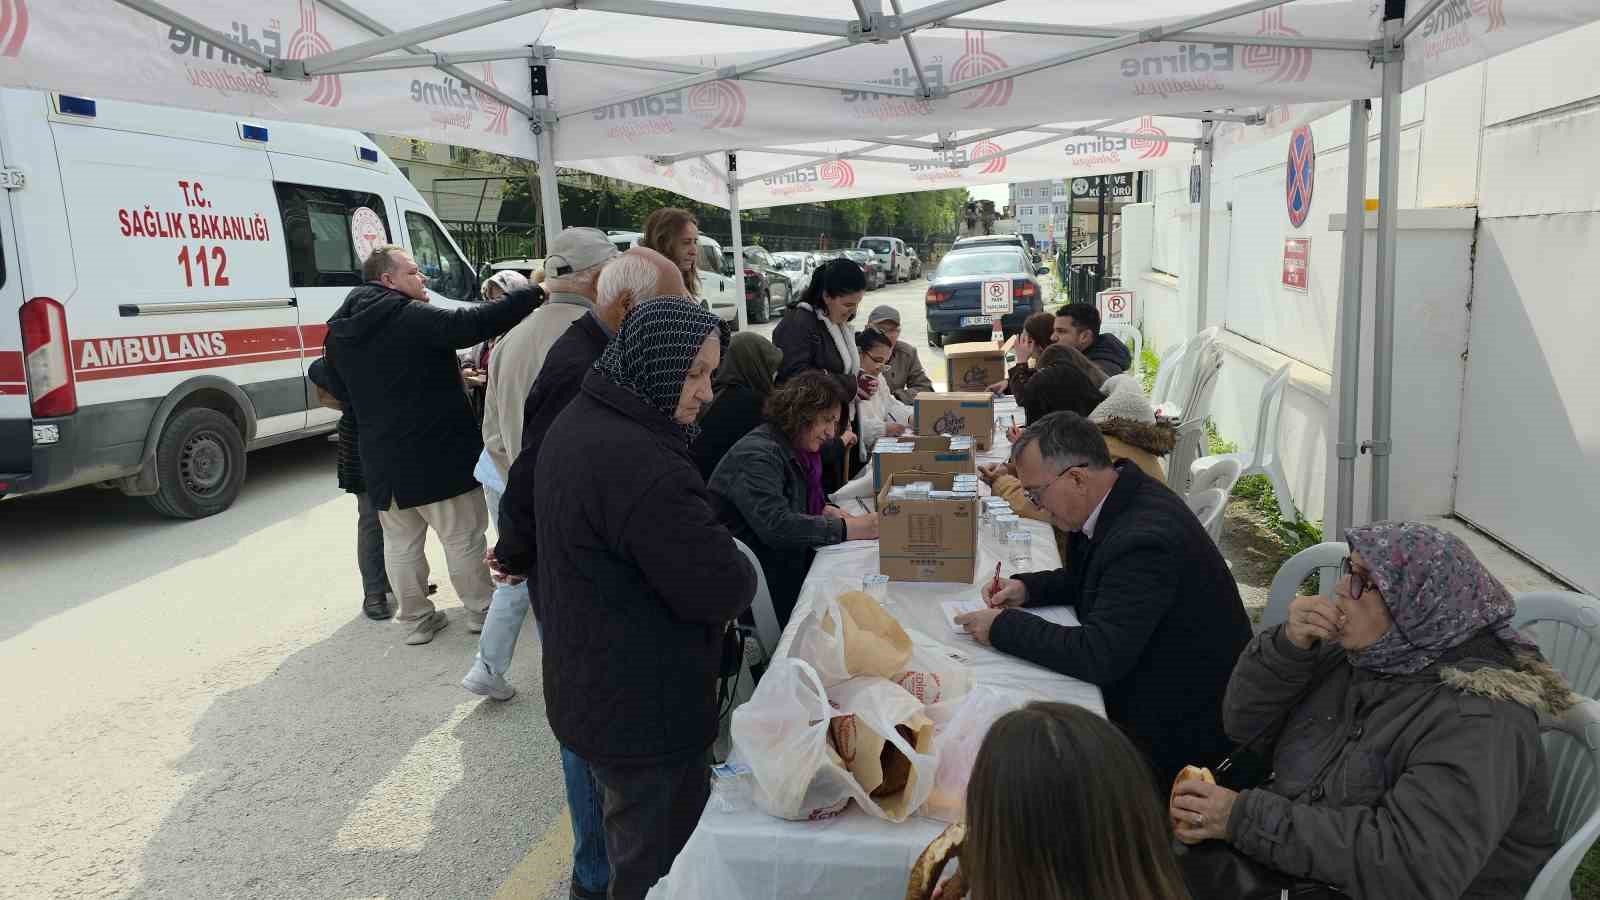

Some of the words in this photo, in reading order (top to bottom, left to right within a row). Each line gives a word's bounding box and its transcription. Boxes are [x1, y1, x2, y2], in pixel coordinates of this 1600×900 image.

[178, 180, 212, 208] T.C.
[1089, 185, 1132, 197] KÜÜRÜ
[118, 204, 186, 238] SAĞLIK
[188, 212, 270, 241] BAKANLIĞI
[177, 245, 229, 287] 112
[80, 332, 227, 369] AMBULANS
